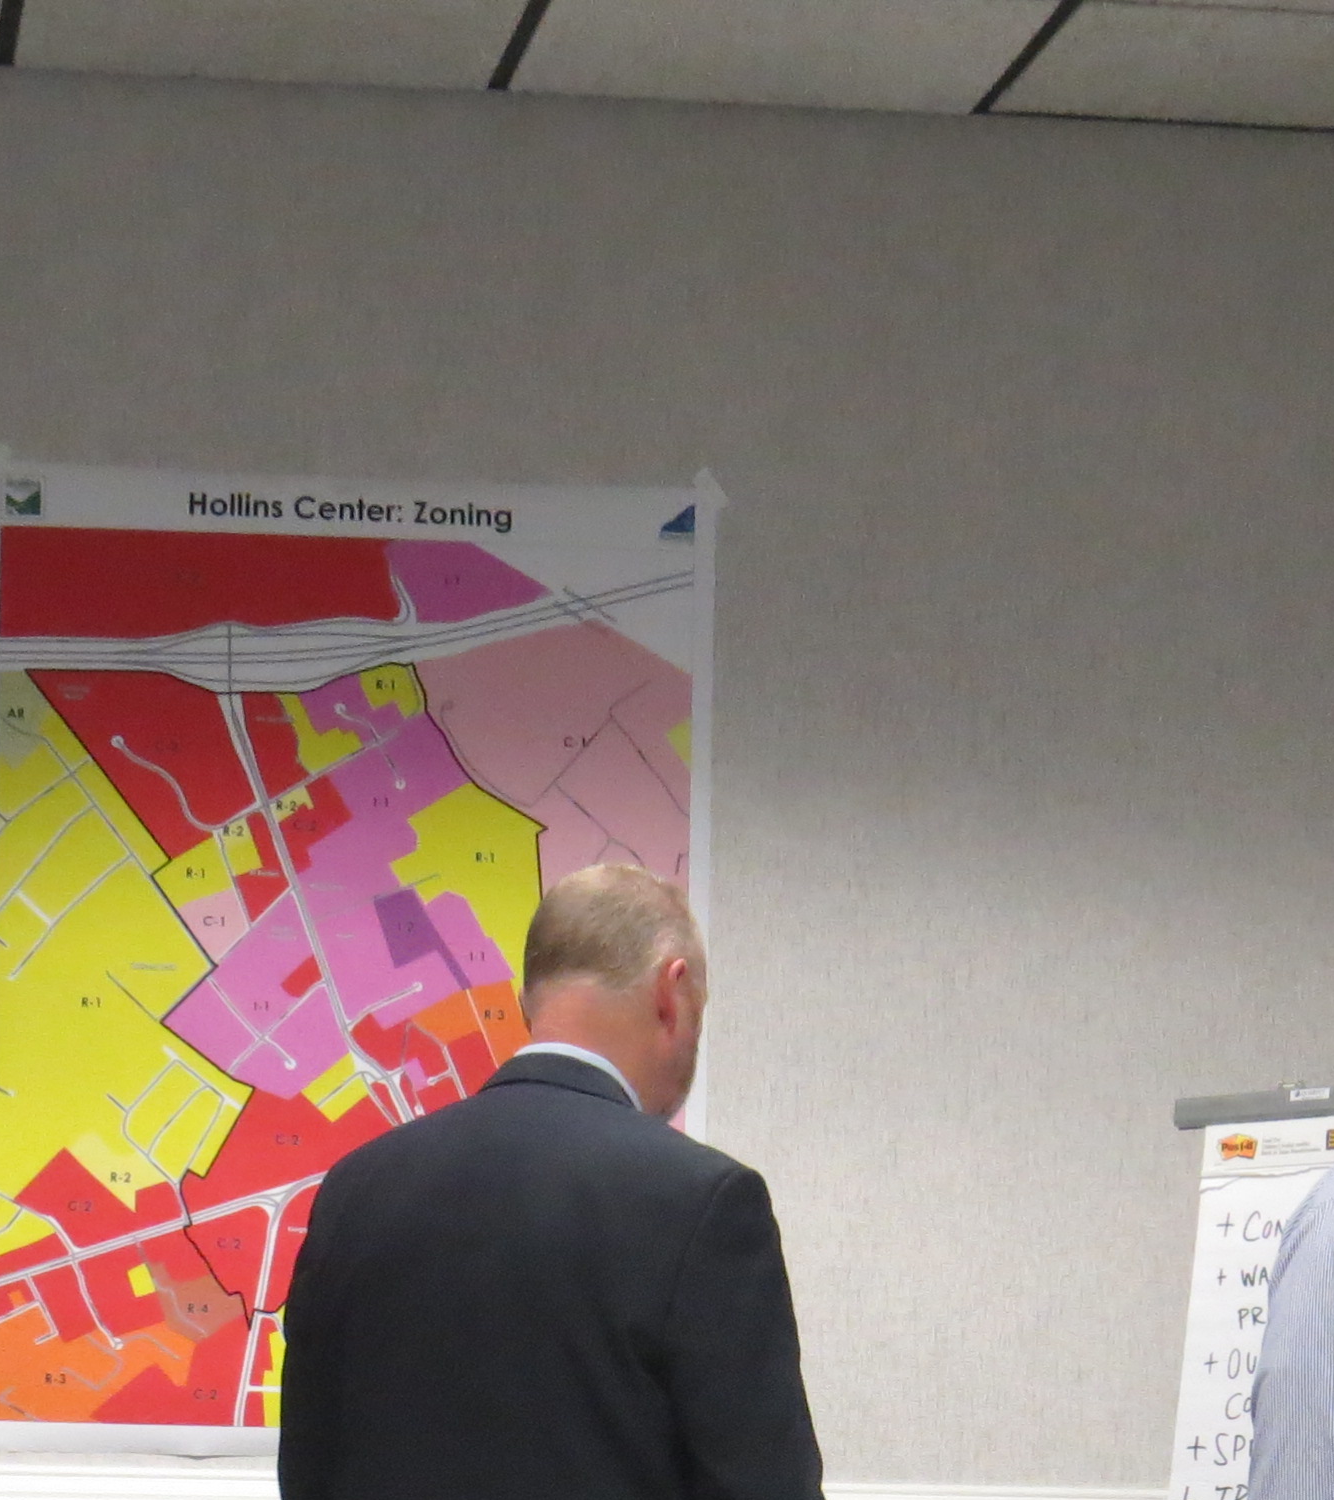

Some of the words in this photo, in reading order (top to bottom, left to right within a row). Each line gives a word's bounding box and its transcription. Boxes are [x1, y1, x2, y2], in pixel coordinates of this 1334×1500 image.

[188, 492, 283, 518] Hollins
[294, 495, 403, 523] Center:
[414, 501, 513, 533] Zoning
[375, 679, 396, 690] R-1
[276, 800, 297, 811] R-2
[222, 825, 244, 836] R-2
[475, 852, 495, 863] R-1
[186, 867, 205, 878] R-1
[203, 915, 226, 927] C-1
[81, 997, 101, 1008] R-1
[275, 1134, 300, 1146] C-2
[110, 1171, 131, 1183] R-2
[217, 1238, 241, 1249] C-2
[45, 1373, 66, 1384] R-3
